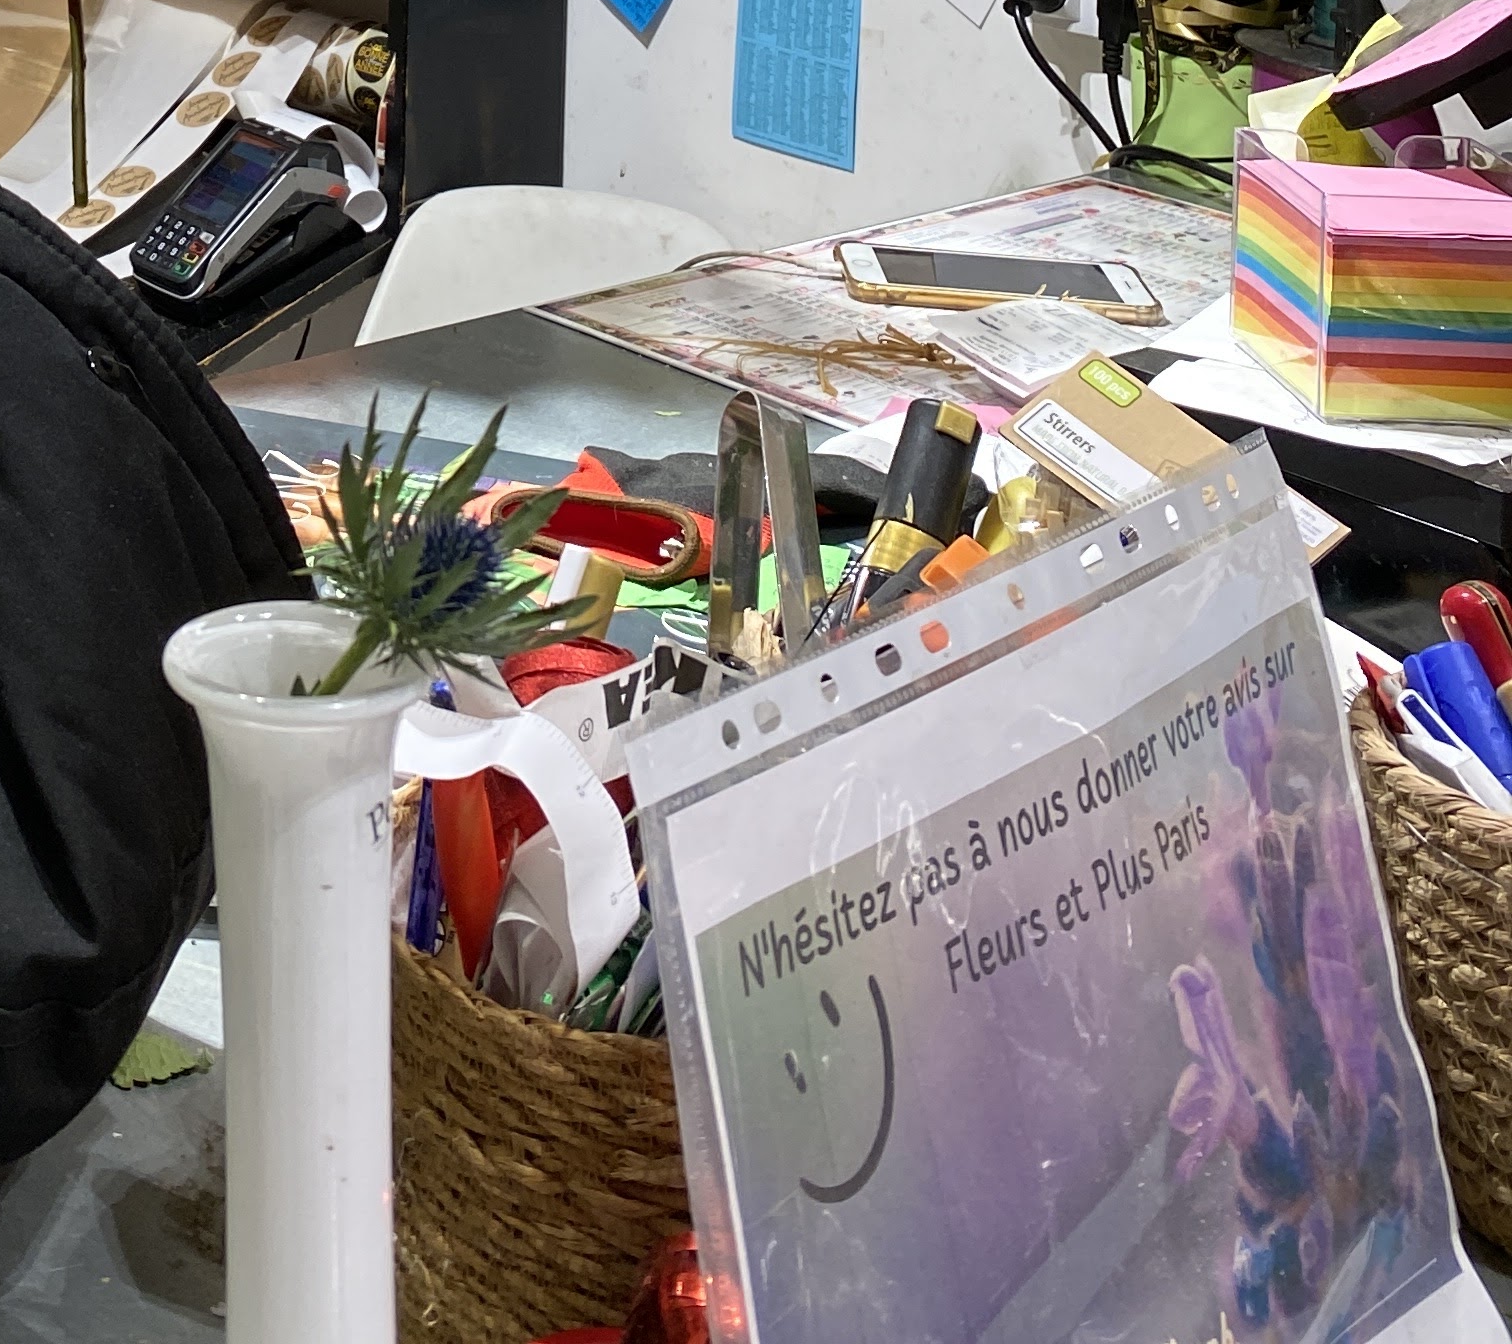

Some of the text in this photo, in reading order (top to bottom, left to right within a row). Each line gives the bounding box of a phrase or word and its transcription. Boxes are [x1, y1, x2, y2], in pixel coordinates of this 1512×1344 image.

[154, 225, 163, 234] 4
[163, 214, 196, 236] 1 2 3
[148, 252, 158, 262] 0
[1088, 365, 1133, 401] 100 pcs
[1043, 412, 1097, 454] Stirrers
[738, 639, 1297, 998] N'hésitez pas à nous donner votre avis sur
[943, 801, 1212, 995] Fleurs et Plus Paris
